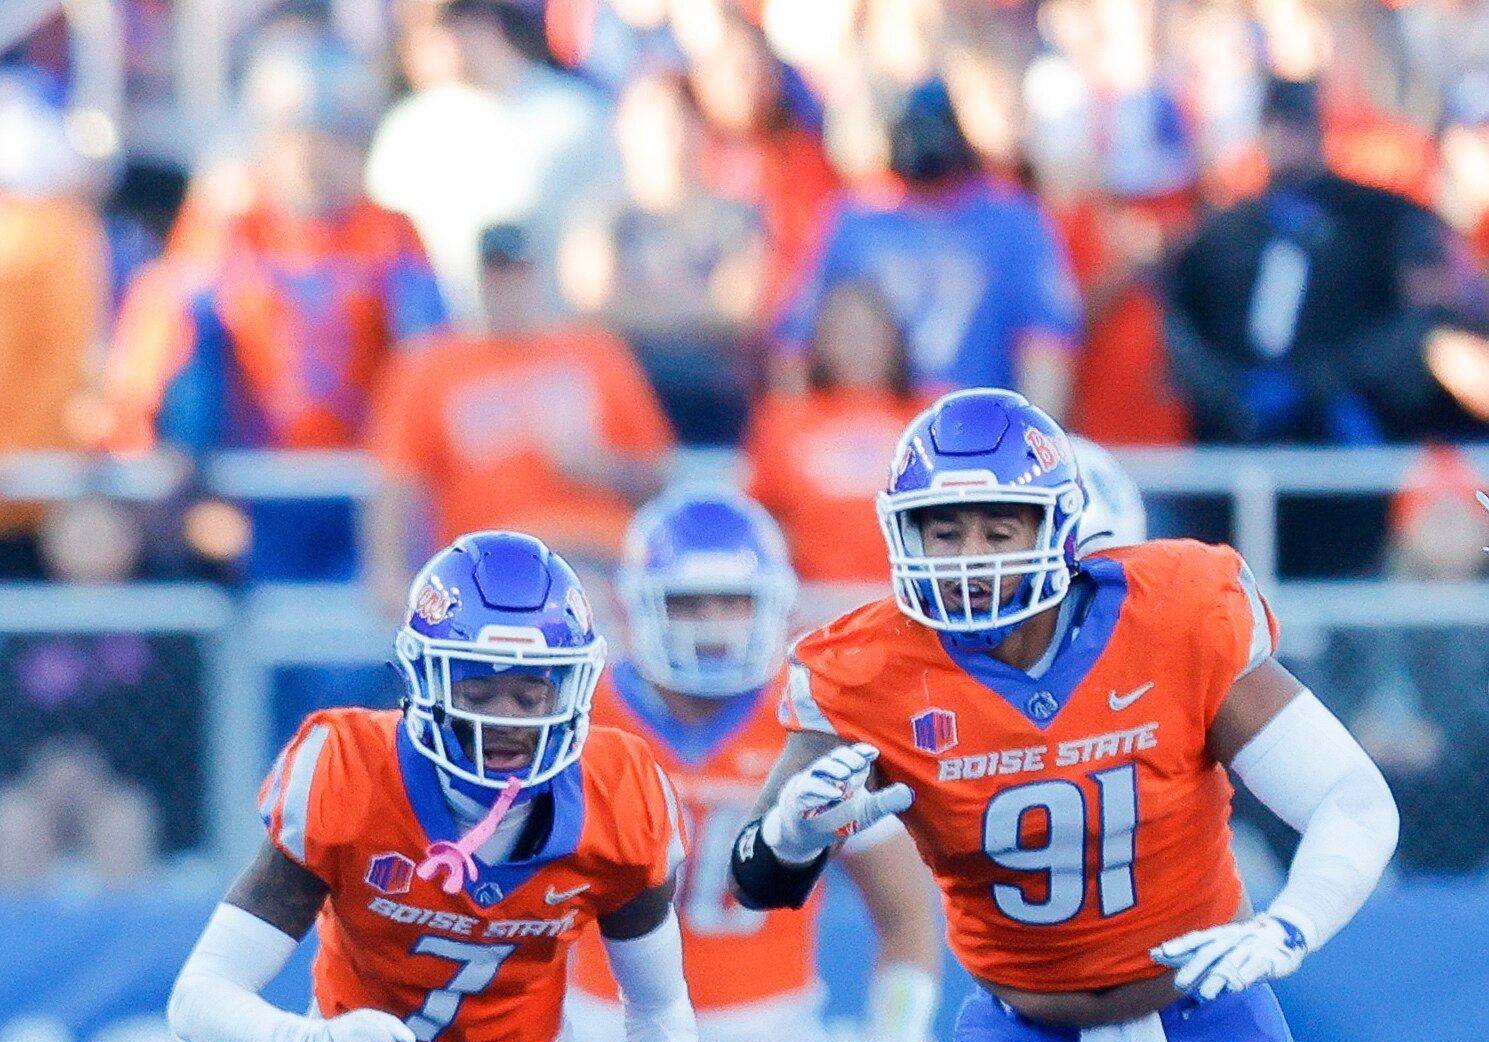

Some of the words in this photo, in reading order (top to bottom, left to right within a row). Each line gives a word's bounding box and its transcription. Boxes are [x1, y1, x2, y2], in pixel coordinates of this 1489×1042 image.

[938, 745, 1048, 781] BOISE
[1055, 721, 1160, 767] STATE
[981, 761, 1139, 926] 91
[367, 896, 480, 936] BOISE
